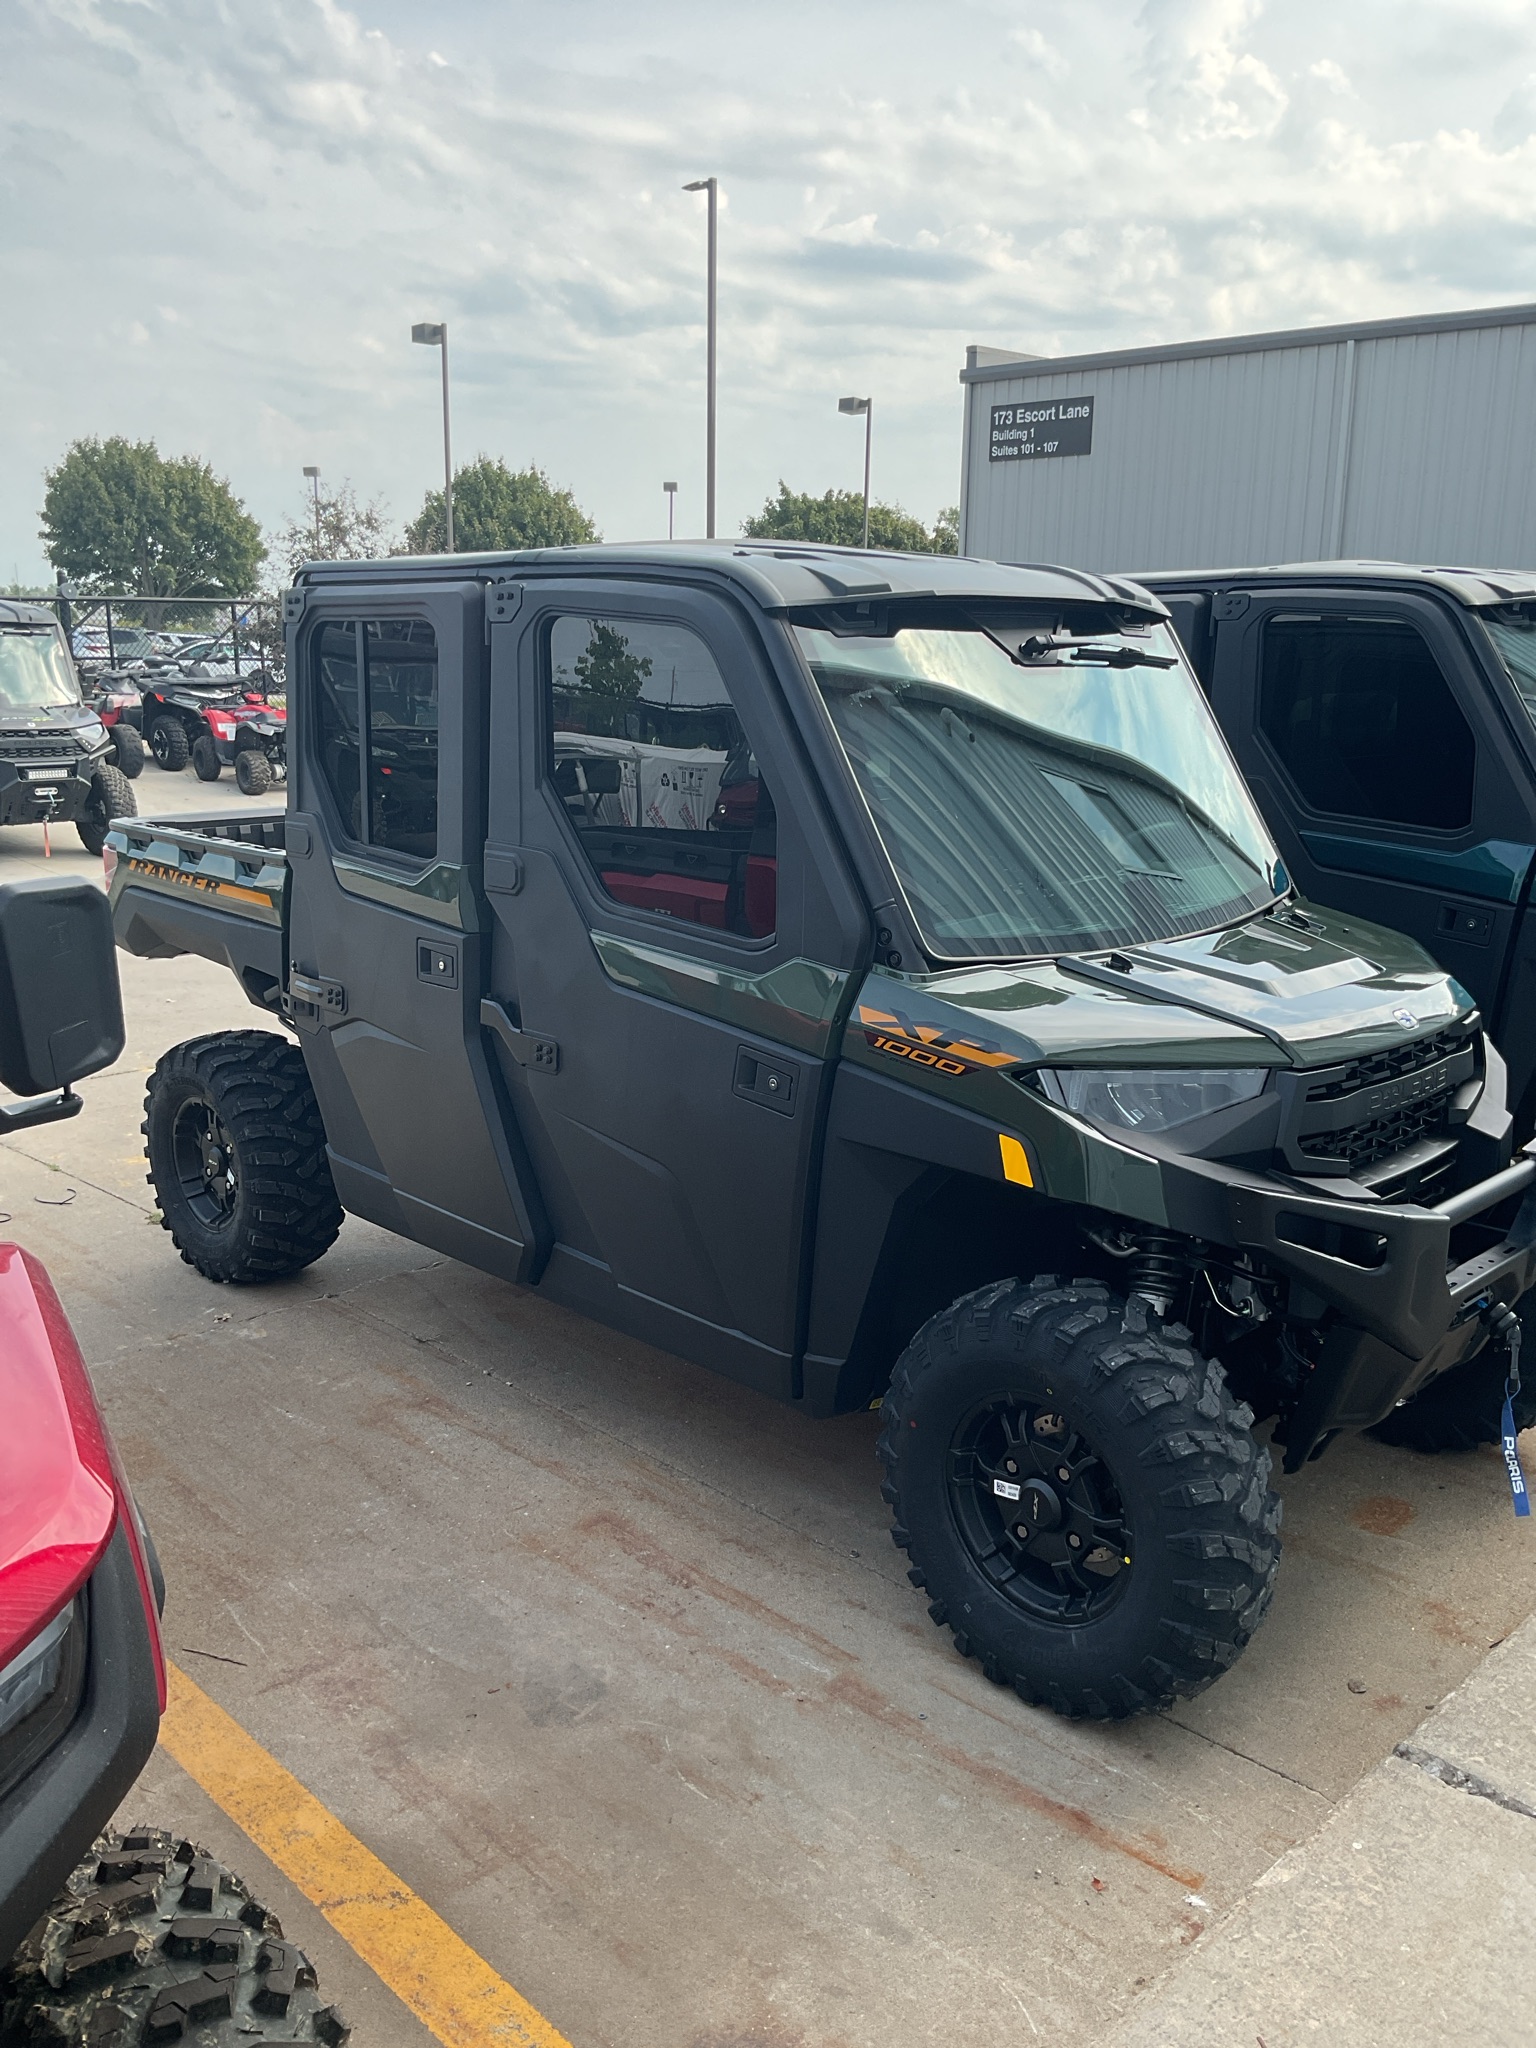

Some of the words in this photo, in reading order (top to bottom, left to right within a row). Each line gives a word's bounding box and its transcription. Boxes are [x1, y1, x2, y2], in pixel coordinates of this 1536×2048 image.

[993, 410, 1013, 425] 173
[1016, 406, 1056, 424] Escort
[1059, 405, 1090, 420] Lane
[991, 445, 1018, 457] Suites
[1020, 444, 1035, 455] 101
[1043, 441, 1059, 453] 107
[992, 429, 1028, 442] Building
[1030, 428, 1035, 438] 1
[131, 858, 221, 894] RANGER
[873, 1036, 966, 1075] 1000
[1504, 1436, 1524, 1494] POLARIS
